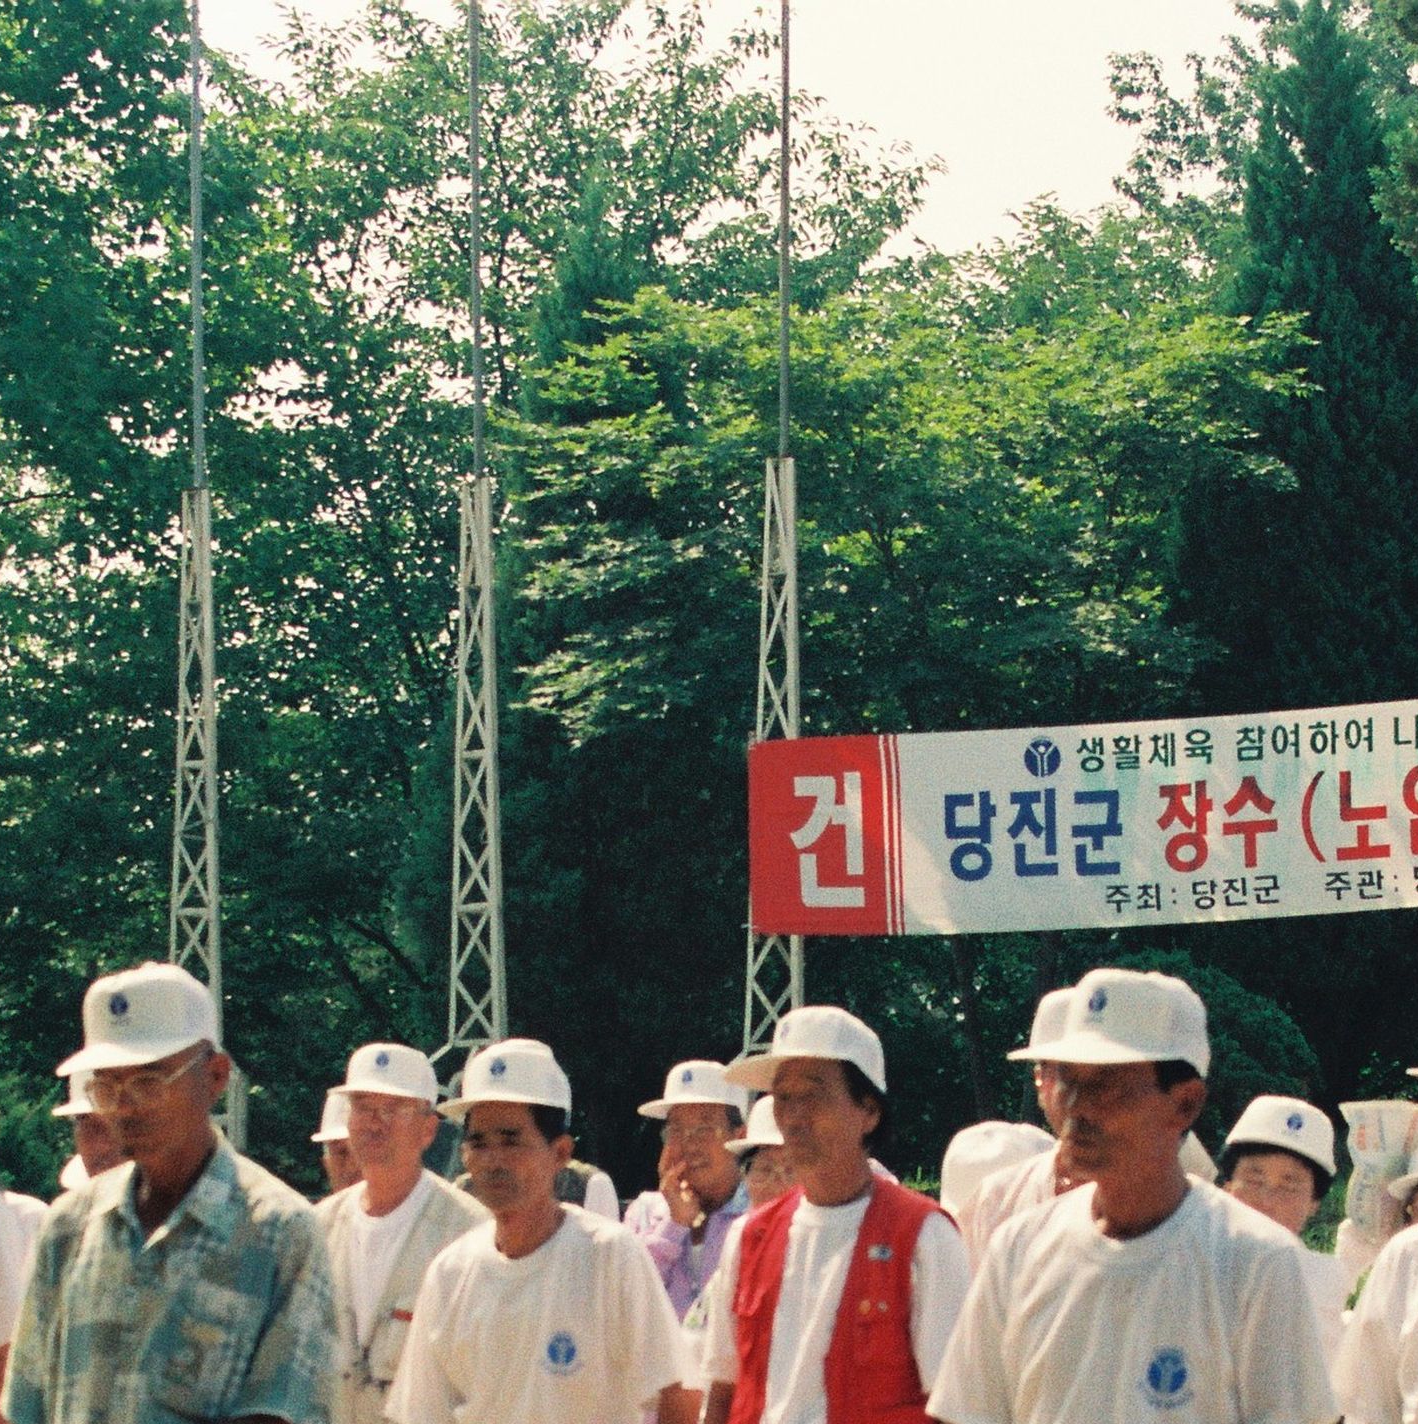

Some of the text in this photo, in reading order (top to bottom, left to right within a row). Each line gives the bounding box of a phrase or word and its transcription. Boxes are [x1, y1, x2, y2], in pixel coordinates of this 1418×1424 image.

[1076, 729, 1214, 773] 생활체육
[1237, 715, 1374, 763] 참여하여
[789, 770, 866, 908] 건
[944, 787, 1124, 882] 당진군
[1191, 873, 1281, 911] 당진군
